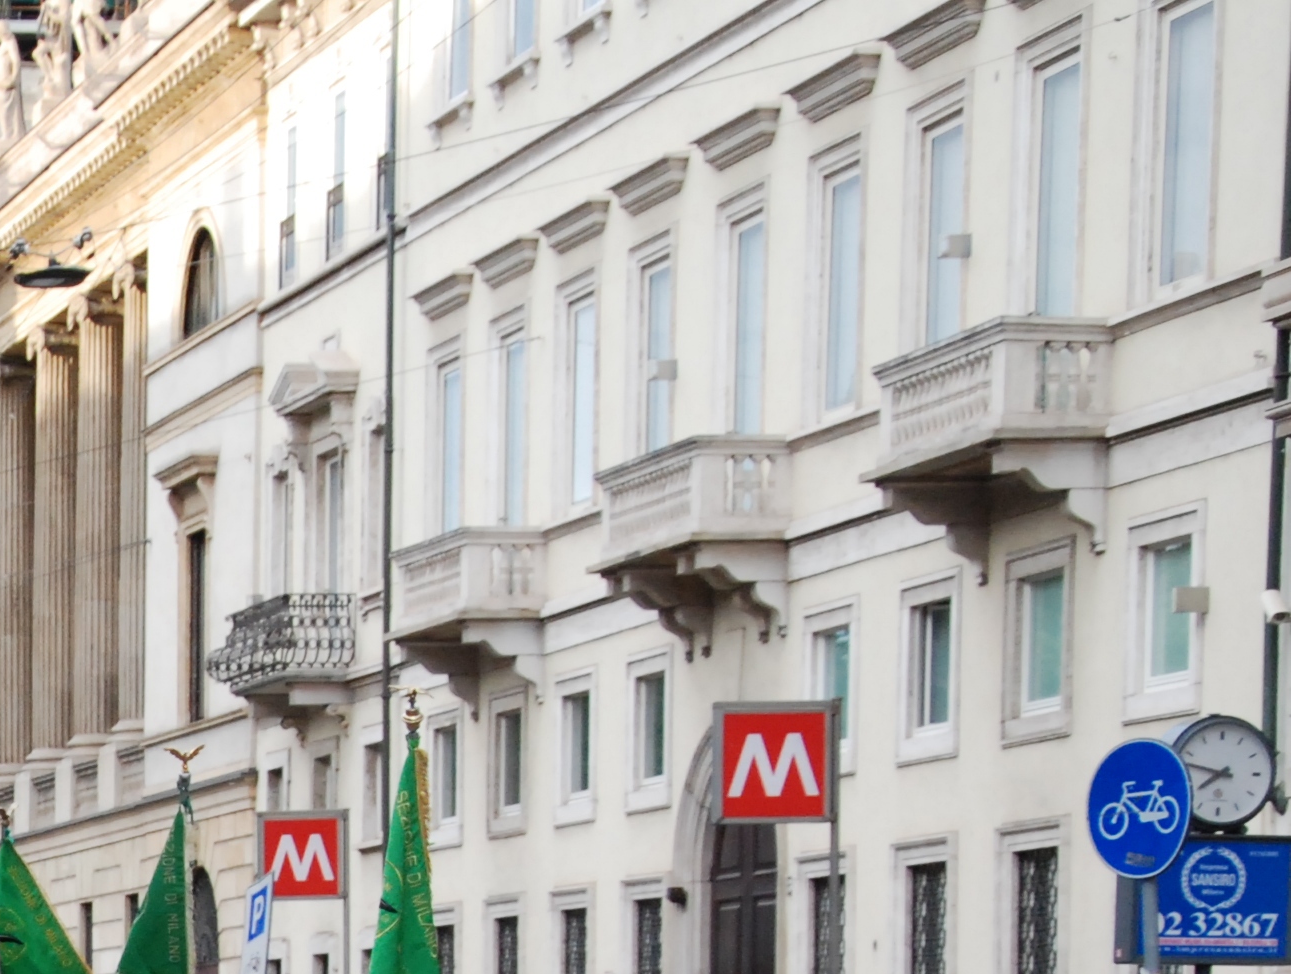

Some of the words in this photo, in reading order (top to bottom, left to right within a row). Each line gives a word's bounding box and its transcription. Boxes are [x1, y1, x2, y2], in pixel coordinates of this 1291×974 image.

[726, 731, 820, 797] M
[271, 834, 335, 882] M
[1191, 873, 1237, 886] SANSIRO
[166, 912, 181, 963] MILANO
[251, 894, 265, 935] P
[407, 870, 421, 887] DI
[414, 893, 439, 958] MILANO
[1188, 912, 1279, 937] 32867
